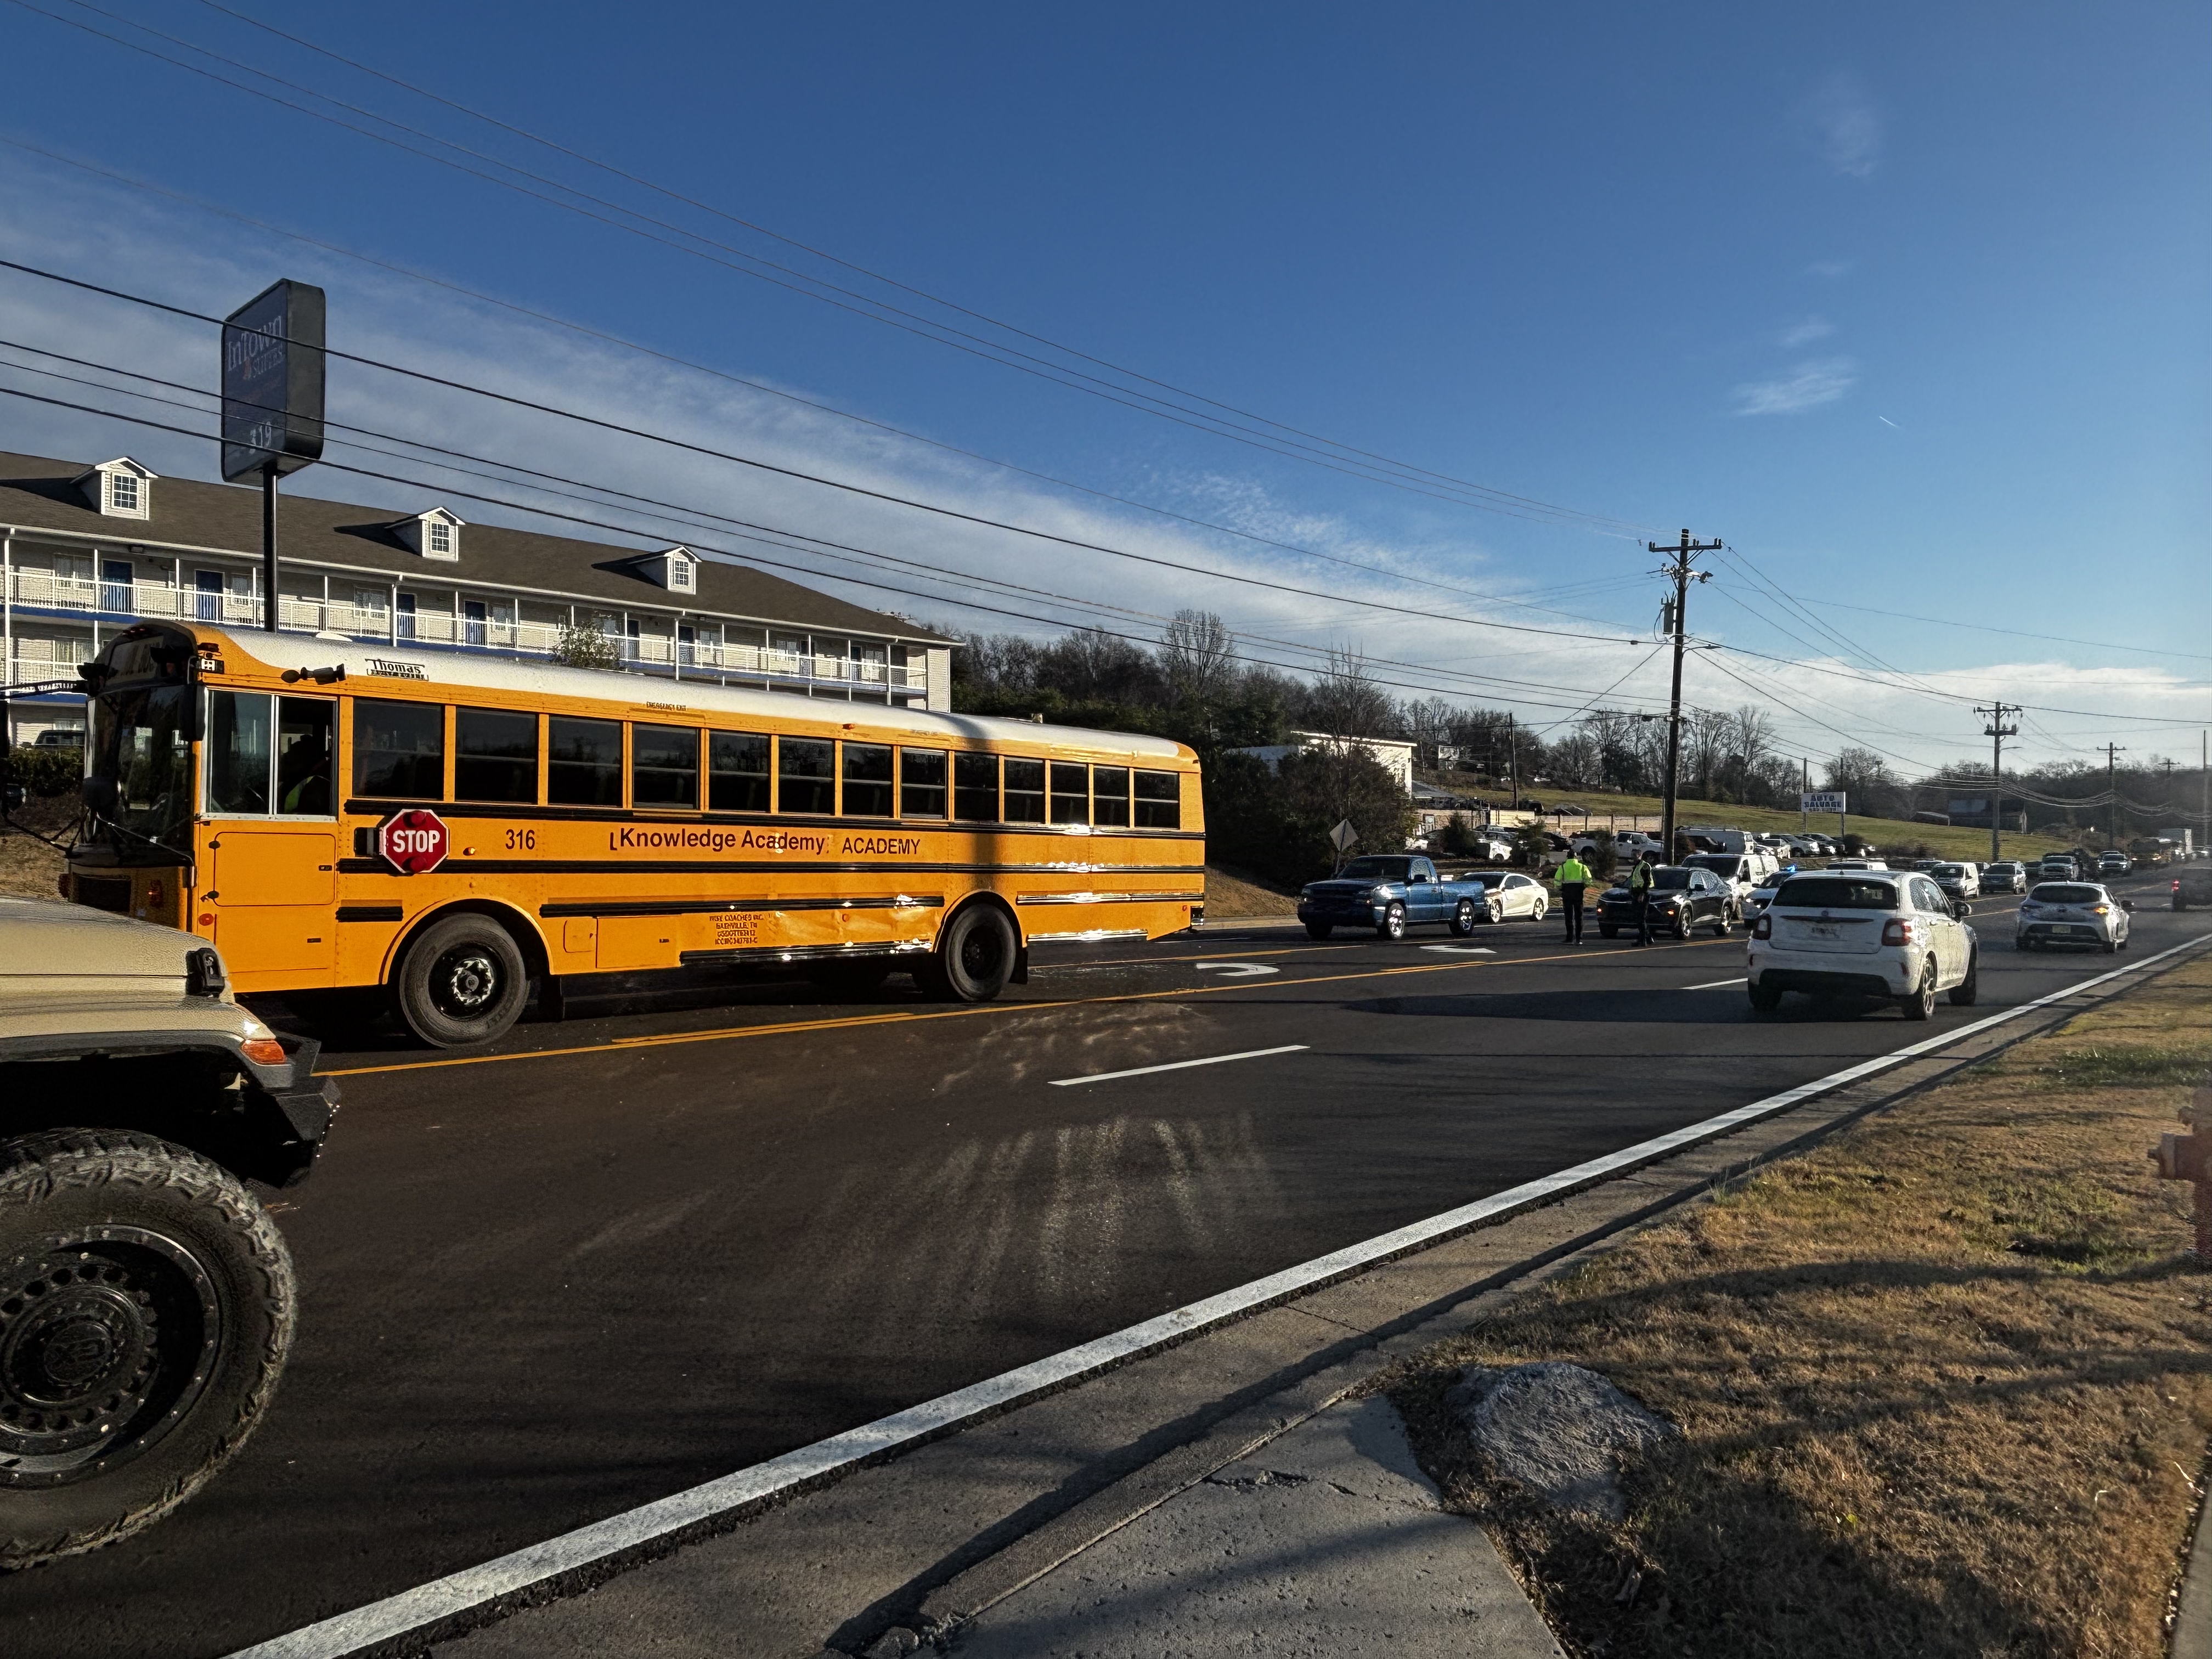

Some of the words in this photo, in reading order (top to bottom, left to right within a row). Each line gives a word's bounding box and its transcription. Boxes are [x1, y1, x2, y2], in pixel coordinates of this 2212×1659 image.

[365, 658, 425, 674] Thomas
[393, 830, 441, 853] STOP
[505, 829, 535, 850] 316
[620, 828, 736, 851] Knowledge
[741, 830, 825, 855] Academy
[842, 837, 920, 854] ACADEMY
